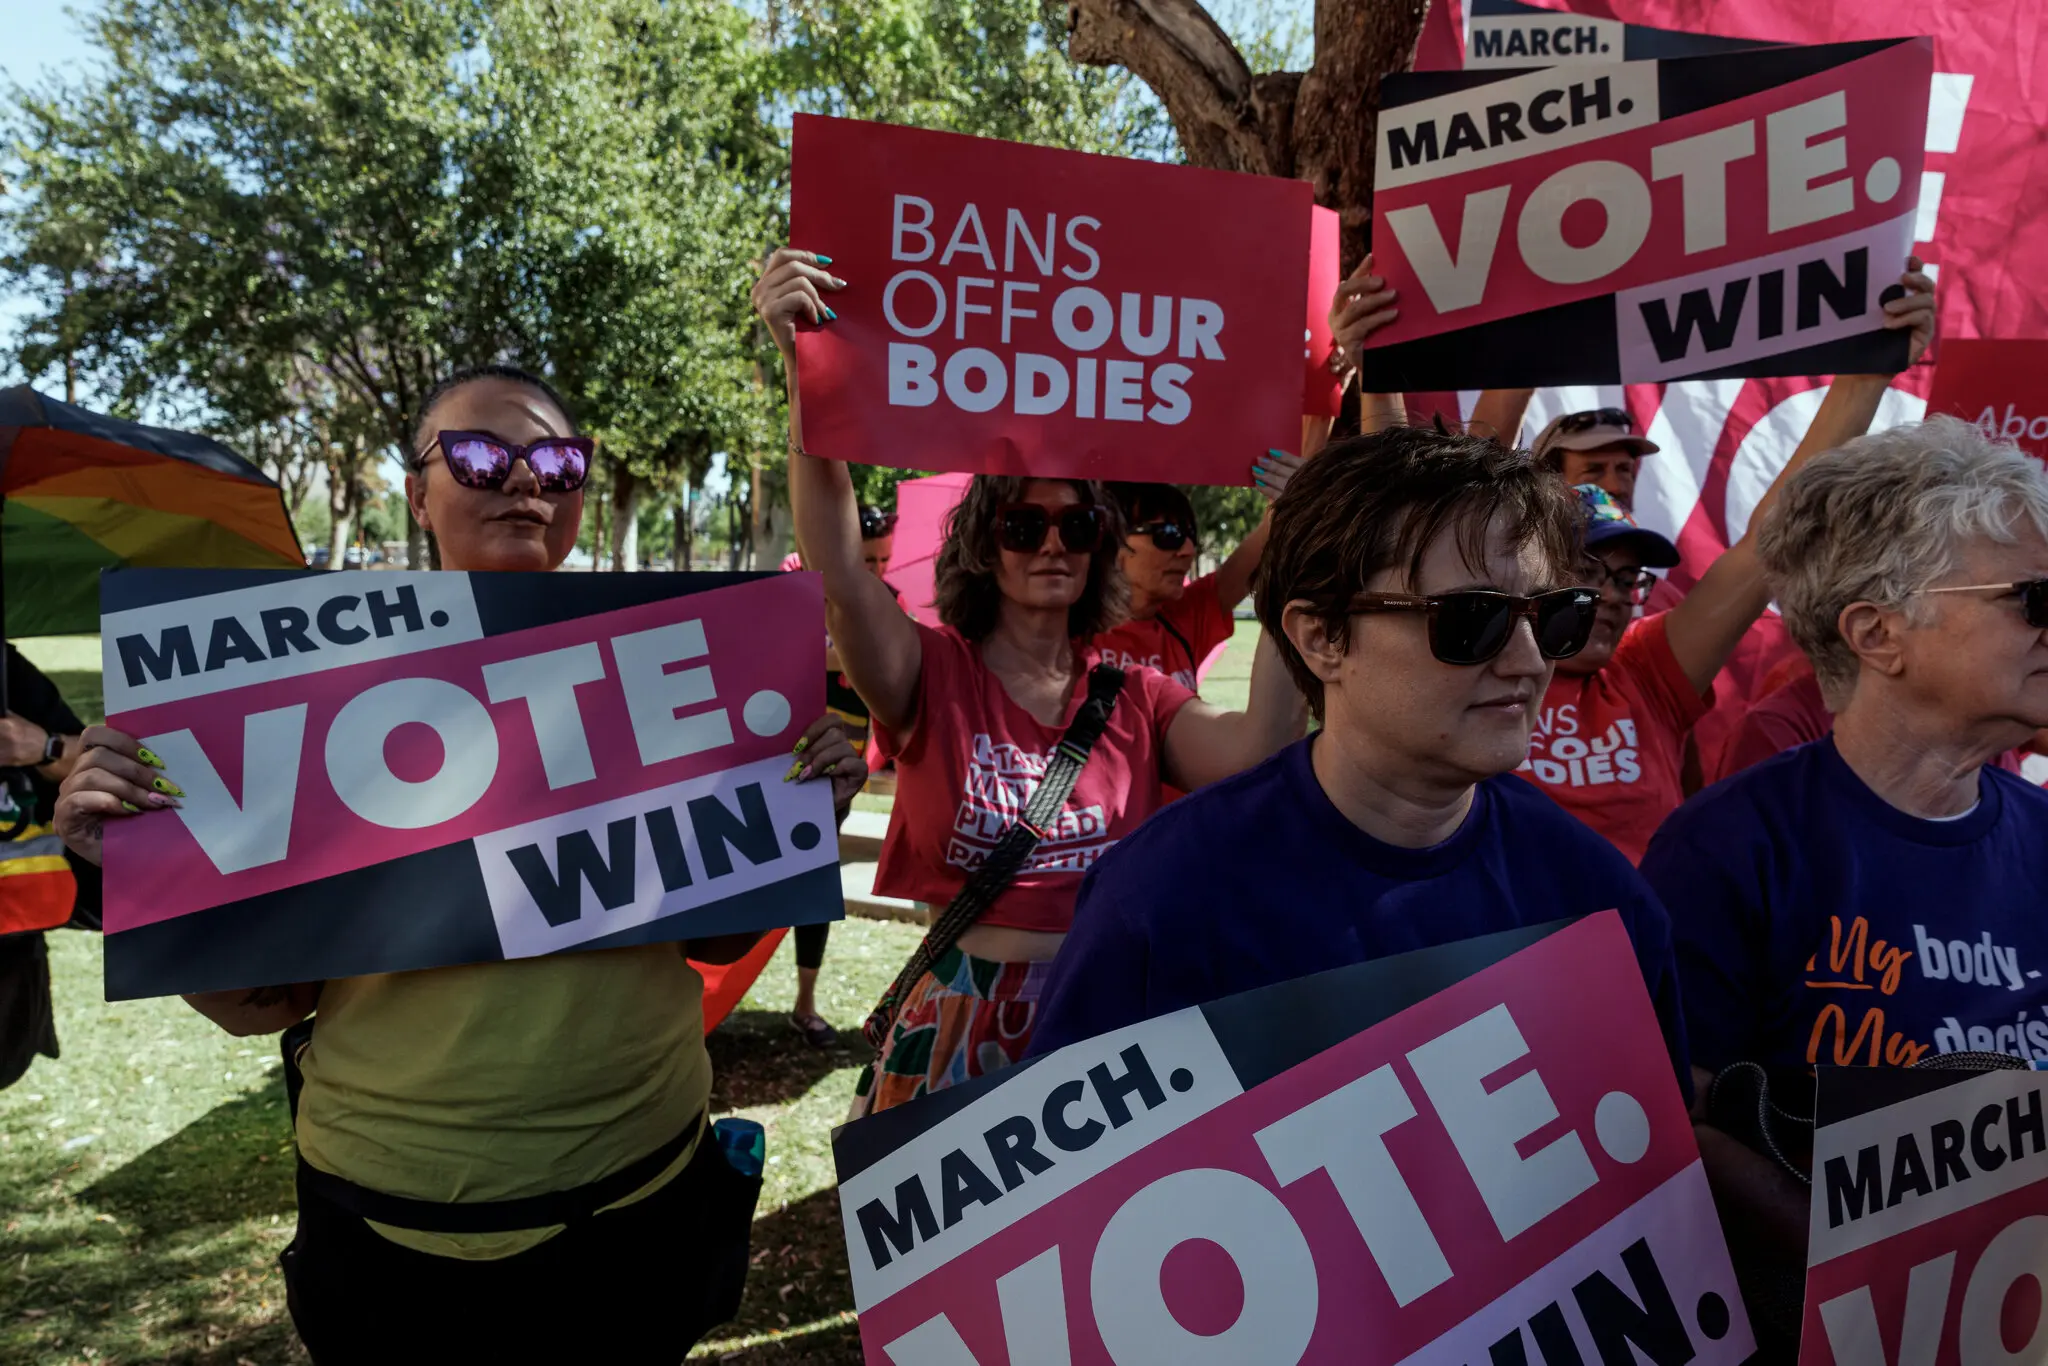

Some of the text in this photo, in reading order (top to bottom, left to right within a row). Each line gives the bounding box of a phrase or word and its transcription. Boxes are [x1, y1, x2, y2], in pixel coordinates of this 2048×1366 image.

[1473, 26, 1610, 58] MARCH.
[1386, 76, 1634, 171] MARCH.
[891, 194, 1102, 282] BANS
[1385, 89, 1901, 315] VOTE.
[1639, 246, 1905, 364] WIN.
[887, 341, 1192, 425] BODIES
[116, 584, 450, 688] MARCH.
[1101, 648, 1163, 673] BAS
[141, 618, 792, 875] VOTE.
[1515, 748, 1641, 787] DIES
[504, 781, 822, 927] WIN.
[957, 808, 1098, 841] PLAED
[1805, 915, 1913, 995] My
[855, 1043, 1194, 1271] MARCH.
[1824, 1088, 2048, 1230] MARCH
